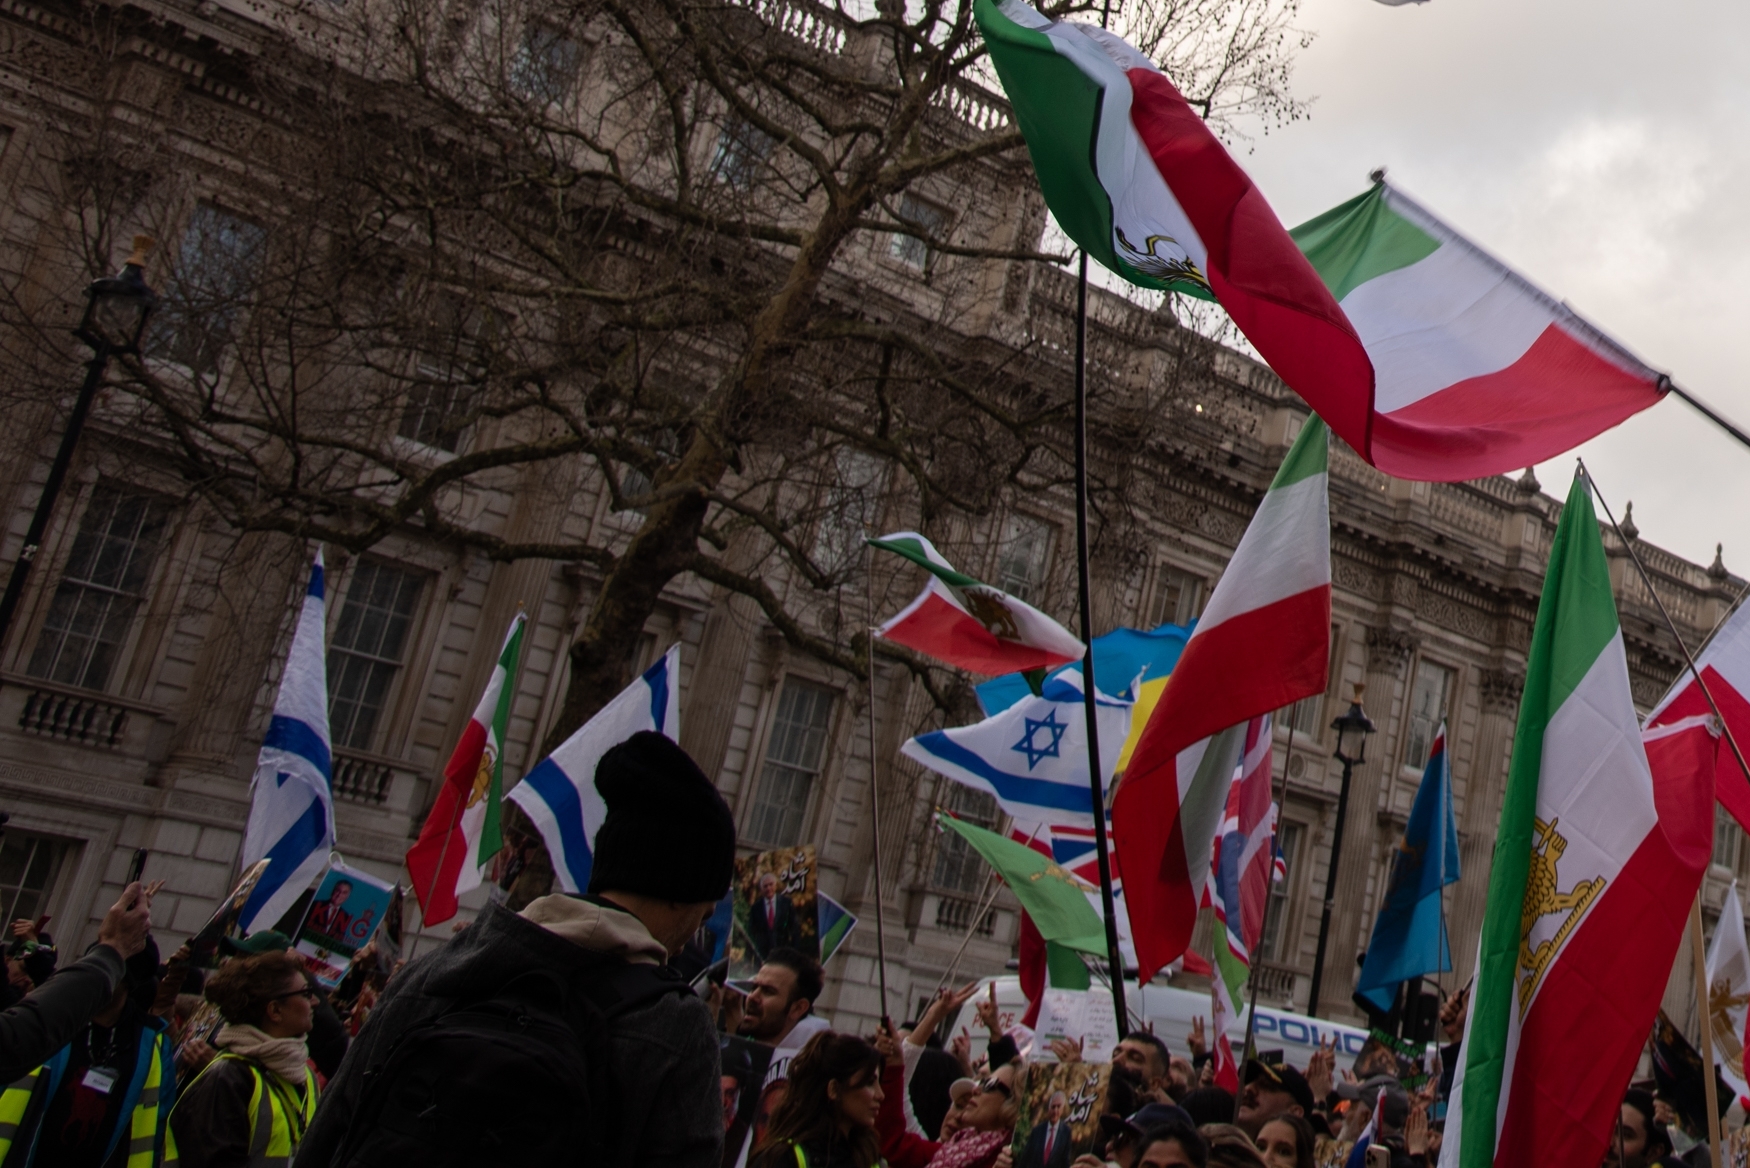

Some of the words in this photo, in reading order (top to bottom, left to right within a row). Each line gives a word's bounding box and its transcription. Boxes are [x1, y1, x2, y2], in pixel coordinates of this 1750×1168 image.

[780, 851, 806, 881] شاه
[1252, 1014, 1367, 1055] POLIC
[1069, 1071, 1098, 1106] شاه
